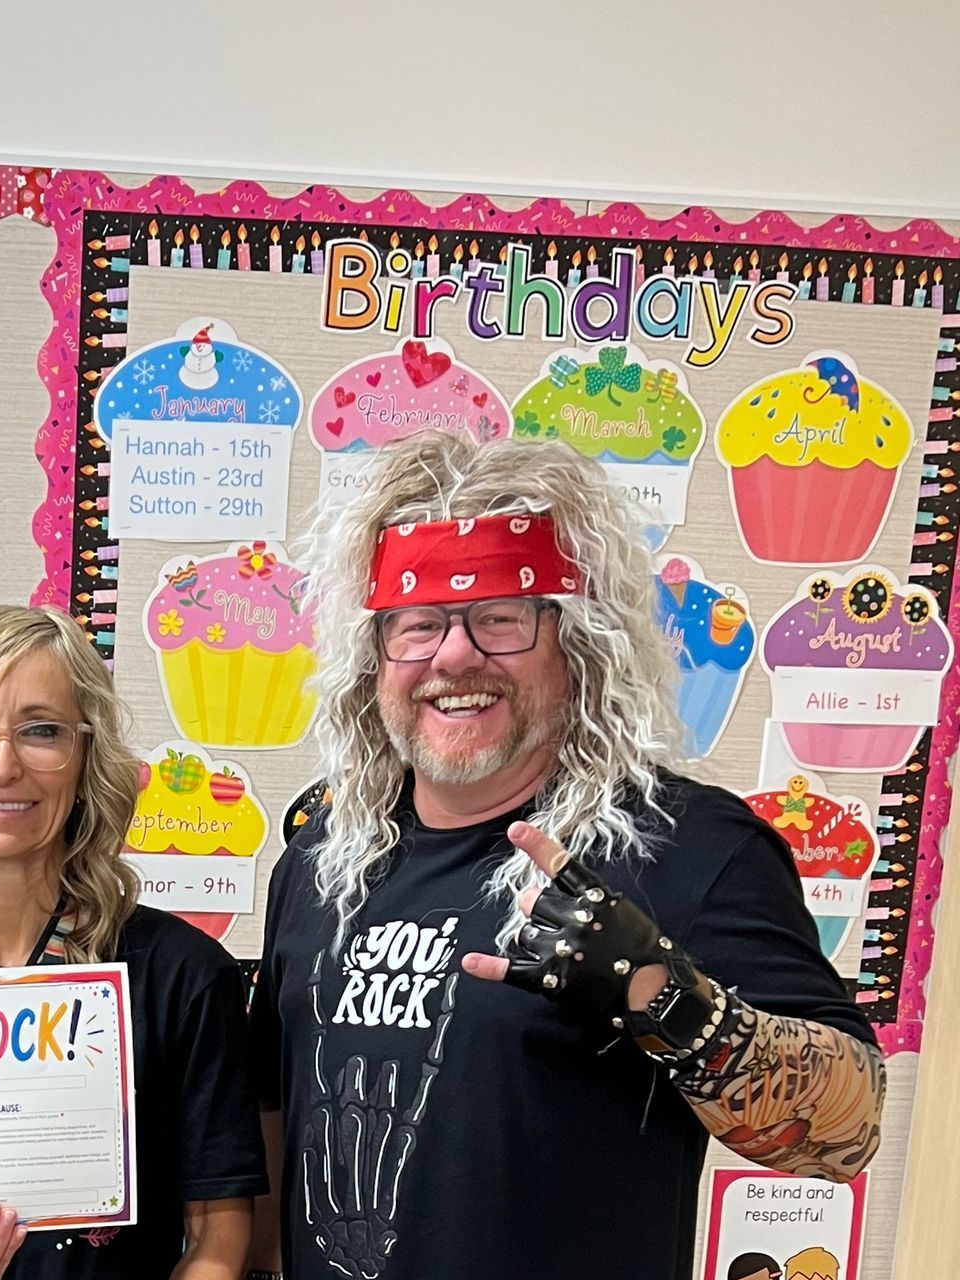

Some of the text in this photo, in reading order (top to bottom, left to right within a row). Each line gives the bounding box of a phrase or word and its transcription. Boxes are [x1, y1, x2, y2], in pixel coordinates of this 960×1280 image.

[324, 241, 796, 367] Birthdays
[151, 385, 246, 423] January
[561, 404, 652, 440] March
[126, 436, 204, 456] Hannah
[229, 439, 272, 458] 15th
[774, 413, 846, 461] April
[131, 465, 195, 485] Austin
[218, 468, 263, 487] 23rd
[129, 495, 196, 515] Sutton
[219, 497, 263, 517] 29th
[214, 589, 277, 640] May
[809, 618, 902, 668] August
[806, 692, 849, 710] Allie
[876, 693, 901, 710] 1st
[132, 806, 233, 847] eptember
[203, 877, 236, 895] 9th
[811, 884, 842, 901] 4th
[356, 920, 450, 973] YOU
[332, 969, 440, 1029] ROCK
[747, 1184, 835, 1200] Be kind and
[745, 1207, 825, 1225] respectful.
